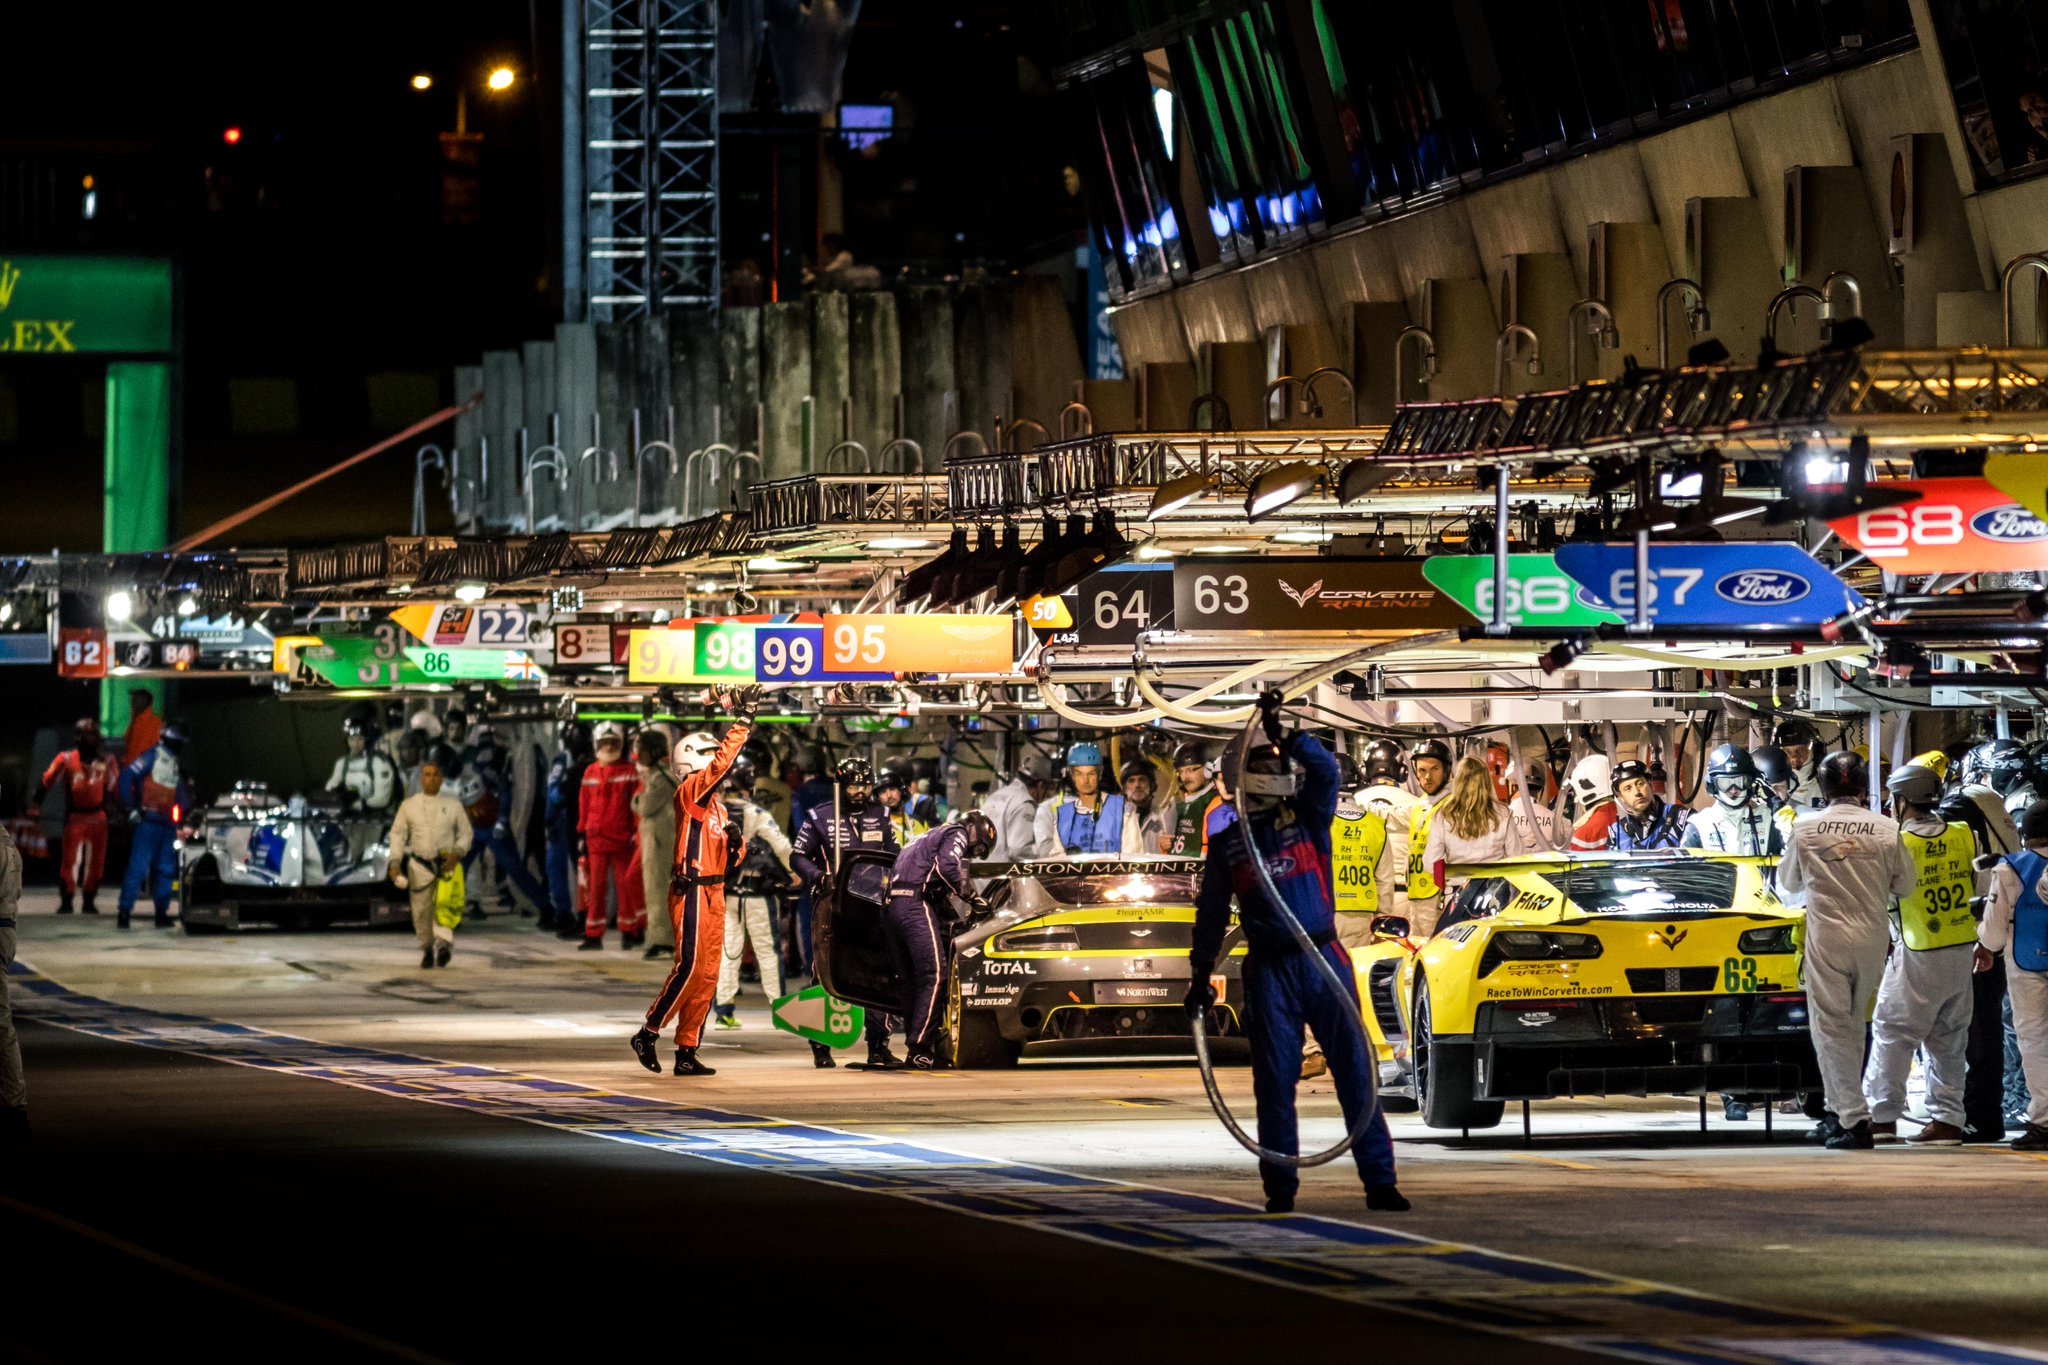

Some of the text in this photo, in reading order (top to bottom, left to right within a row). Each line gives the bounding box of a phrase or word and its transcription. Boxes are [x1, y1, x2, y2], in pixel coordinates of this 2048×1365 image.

[1858, 505, 1964, 547] 68
[559, 591, 579, 609] 48
[622, 588, 685, 598] PROTOTYPES
[1194, 574, 1250, 614] 63
[1318, 590, 1435, 599] CORVETTE
[1475, 577, 1570, 616] 66
[1610, 568, 1791, 615] 67 Ford
[1031, 600, 1057, 622] 50
[1094, 589, 1150, 630] 64
[1321, 599, 1431, 610] RACING
[152, 615, 176, 639] 41
[481, 611, 526, 642] 22
[164, 643, 194, 664] 84
[560, 628, 582, 659] 8
[706, 630, 754, 671] 98
[833, 623, 886, 664] 95
[423, 652, 450, 674] 86
[762, 636, 814, 676] 99
[1817, 821, 1876, 836] OFFICIAL
[1007, 863, 1083, 876] ASTON
[1090, 862, 1178, 874] MARTIN
[1338, 864, 1371, 887] 408
[1924, 865, 1938, 876] RH
[1948, 860, 1960, 871] TV
[1916, 876, 1940, 887] TLANE
[1514, 891, 1555, 911] FARO
[1666, 902, 1720, 910] INOLTA
[1923, 883, 1968, 915] 392
[1116, 908, 1165, 917] #teamAMR
[983, 960, 1037, 976] TOTAL
[1510, 969, 1577, 977] RACING
[1724, 957, 1758, 993] 63
[973, 998, 1012, 1006] DUNLOP
[1486, 985, 1613, 998] RaceToWinCorvette.com
